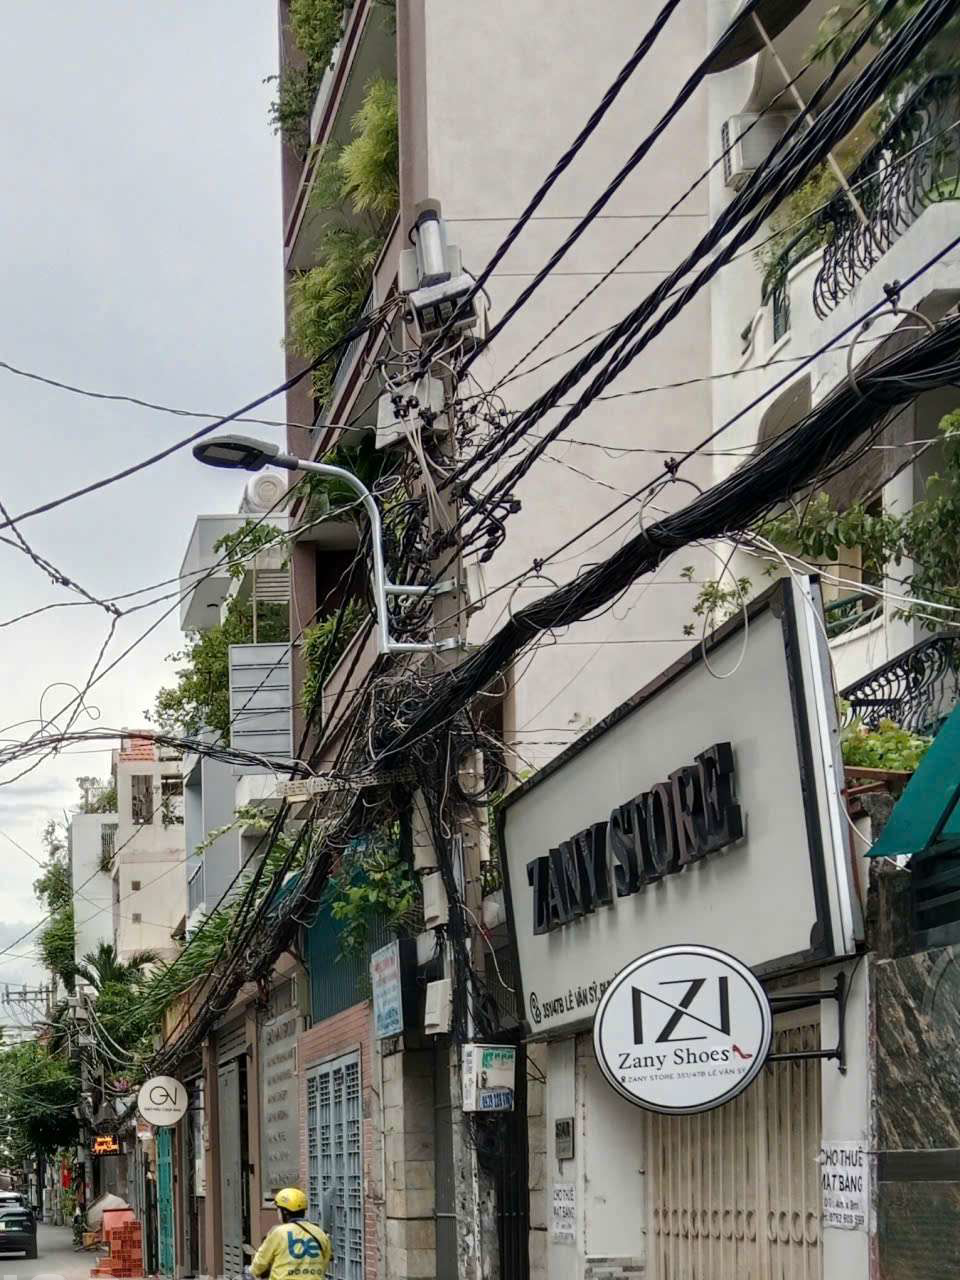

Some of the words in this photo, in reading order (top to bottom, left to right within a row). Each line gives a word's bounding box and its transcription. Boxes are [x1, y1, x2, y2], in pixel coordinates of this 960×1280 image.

[527, 821, 613, 935] ZANY
[610, 742, 743, 897] STORE
[618, 1053, 667, 1070] Zany
[673, 1048, 730, 1065] Shoes
[649, 1073, 674, 1081] STORE
[840, 1145, 863, 1168] THUÊ
[287, 1231, 322, 1260] be
